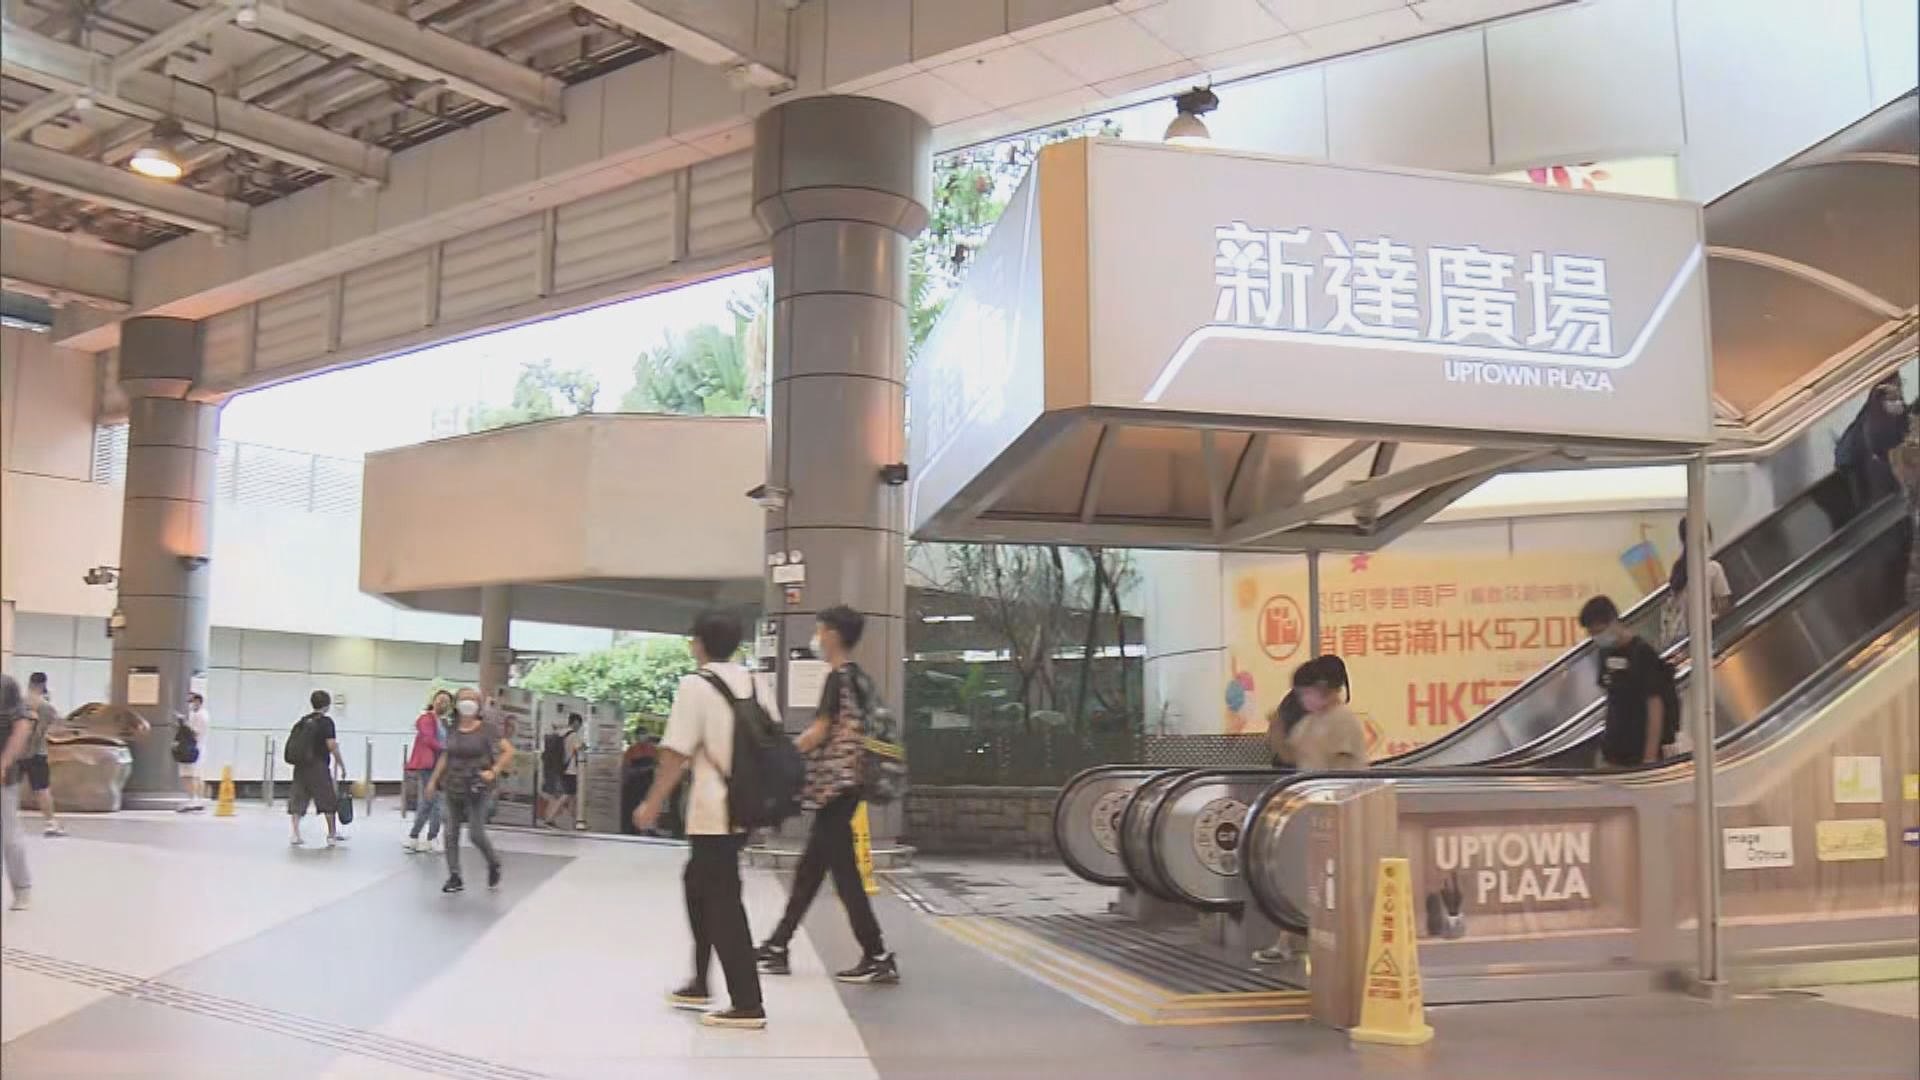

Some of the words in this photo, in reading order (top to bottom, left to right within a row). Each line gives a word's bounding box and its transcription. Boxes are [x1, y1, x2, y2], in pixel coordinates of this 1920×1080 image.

[1215, 220, 1613, 354] 新達廣場
[1445, 359, 1541, 387] UPTOWN
[1548, 367, 1615, 392] PLAZA
[1407, 679, 1523, 726] HK$
[1435, 831, 1591, 870] UPTOWN
[1477, 866, 1590, 904] PLAZA
